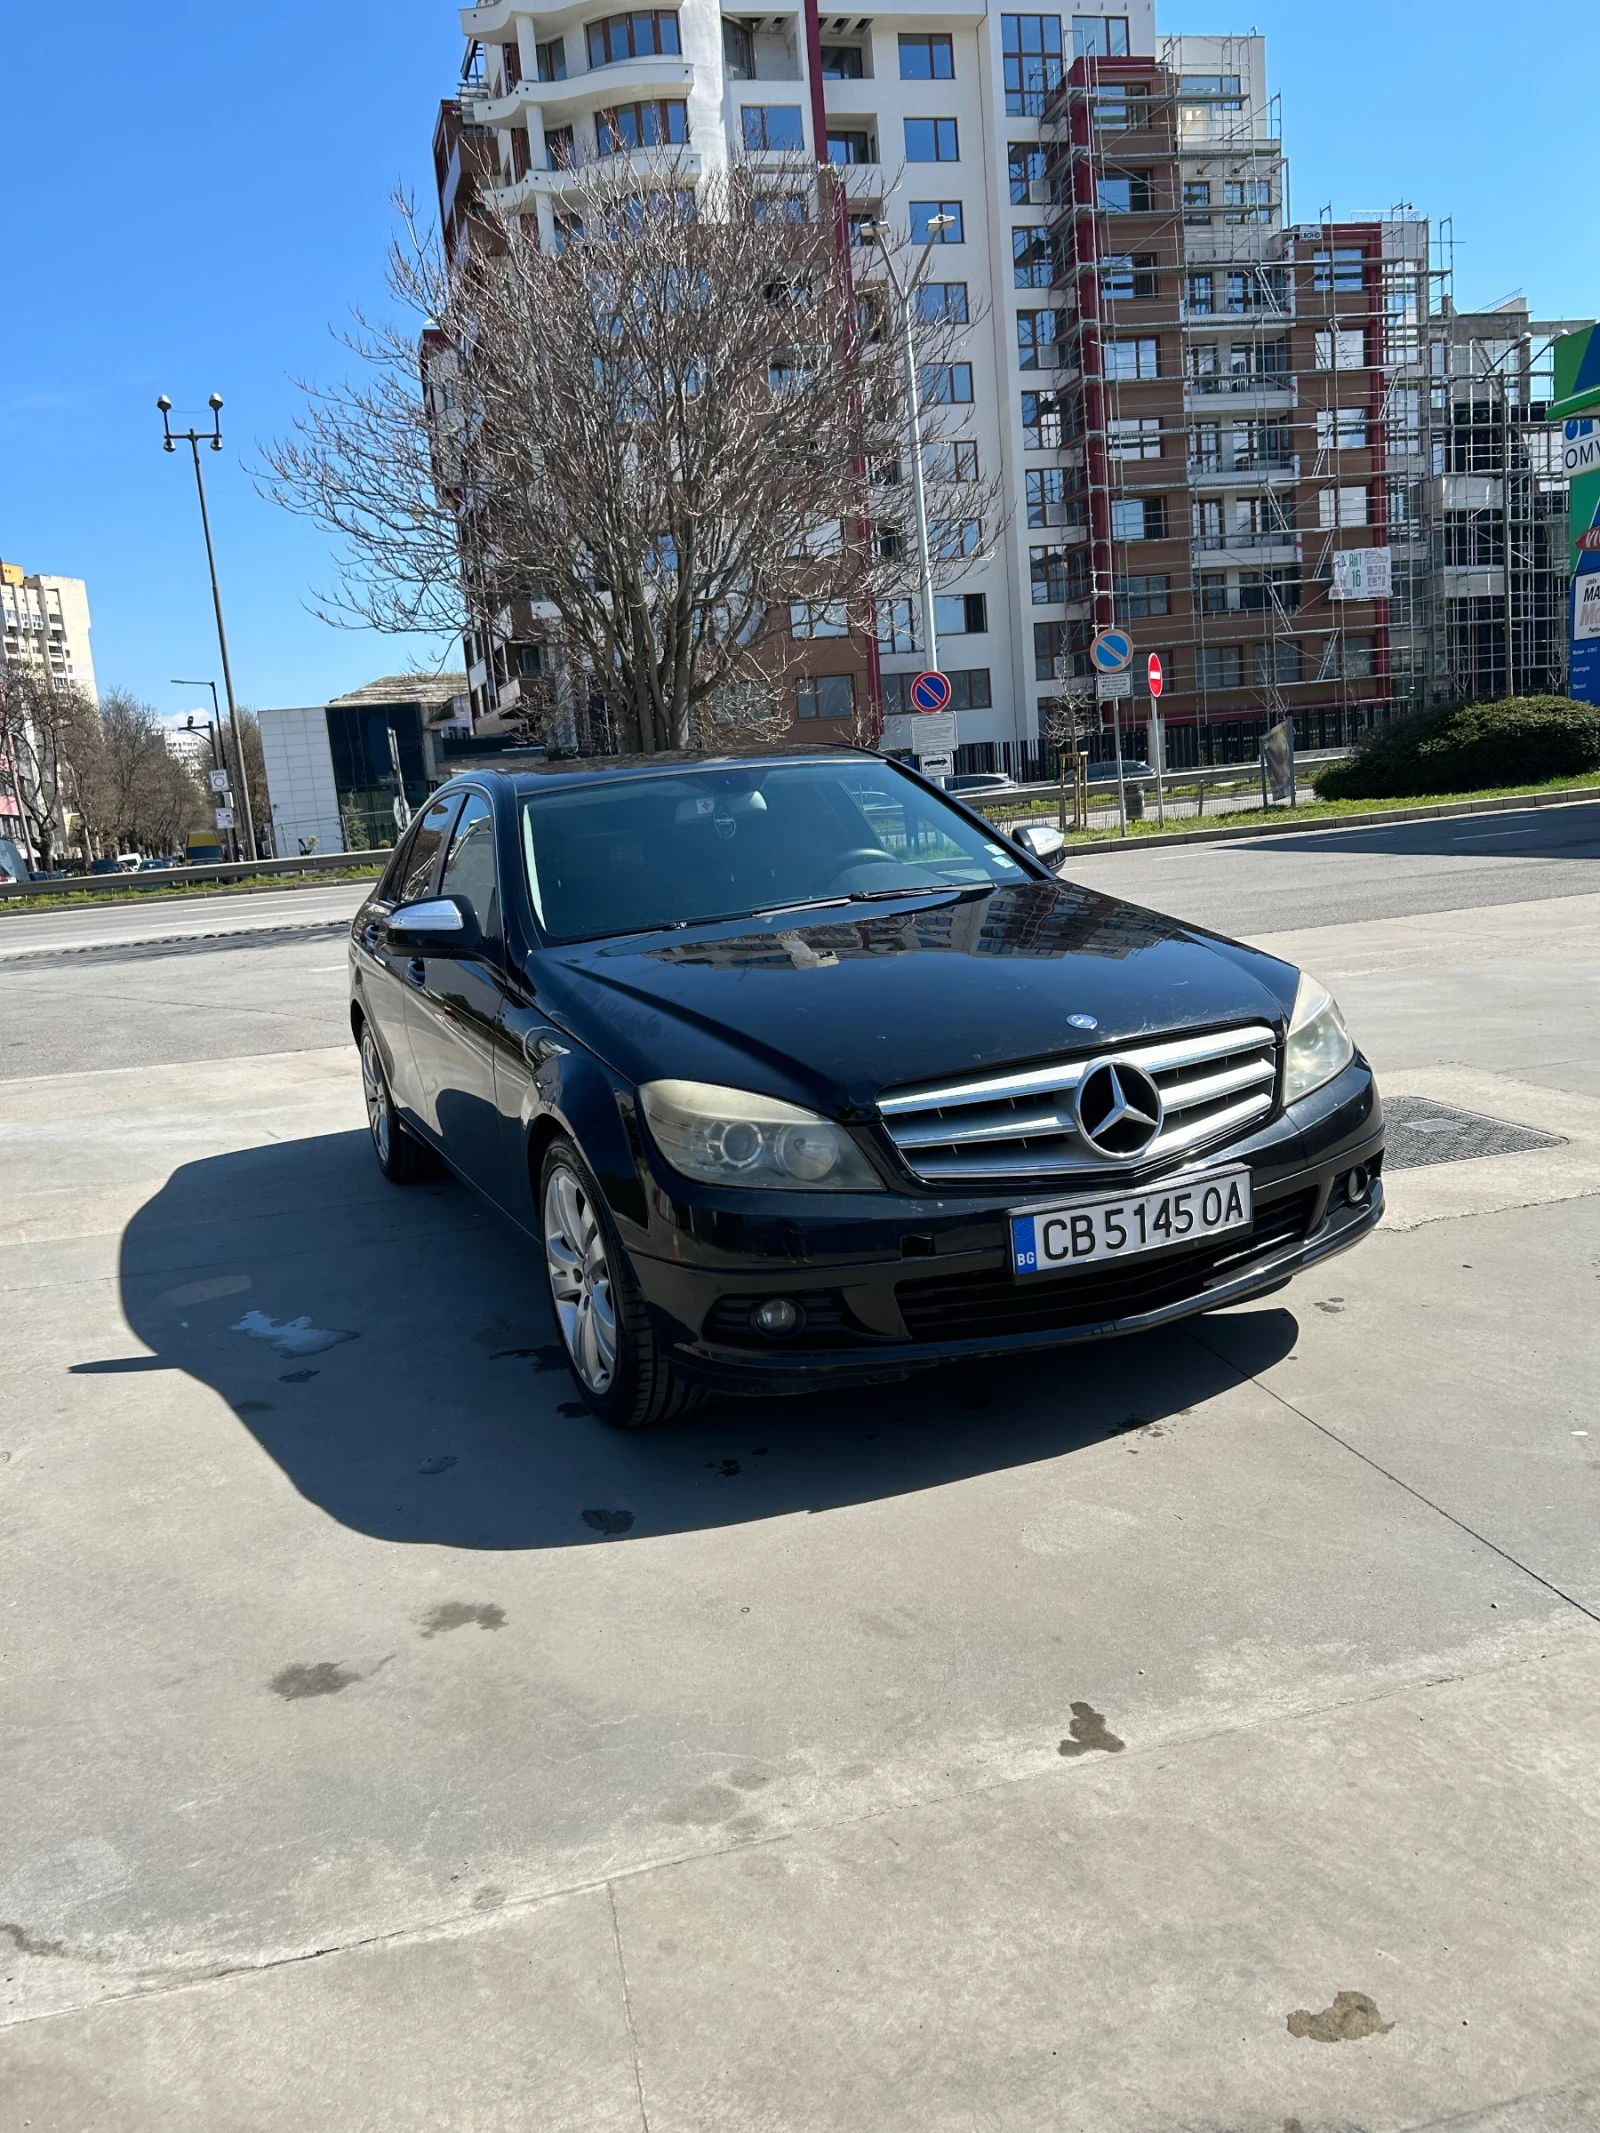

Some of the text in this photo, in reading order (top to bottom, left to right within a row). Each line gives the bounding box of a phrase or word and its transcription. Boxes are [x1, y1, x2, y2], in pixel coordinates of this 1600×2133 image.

[1351, 569, 1361, 588] 16
[1043, 1215, 1096, 1260] CB
[1104, 1193, 1194, 1250] 5145
[1017, 1251, 1035, 1266] BG
